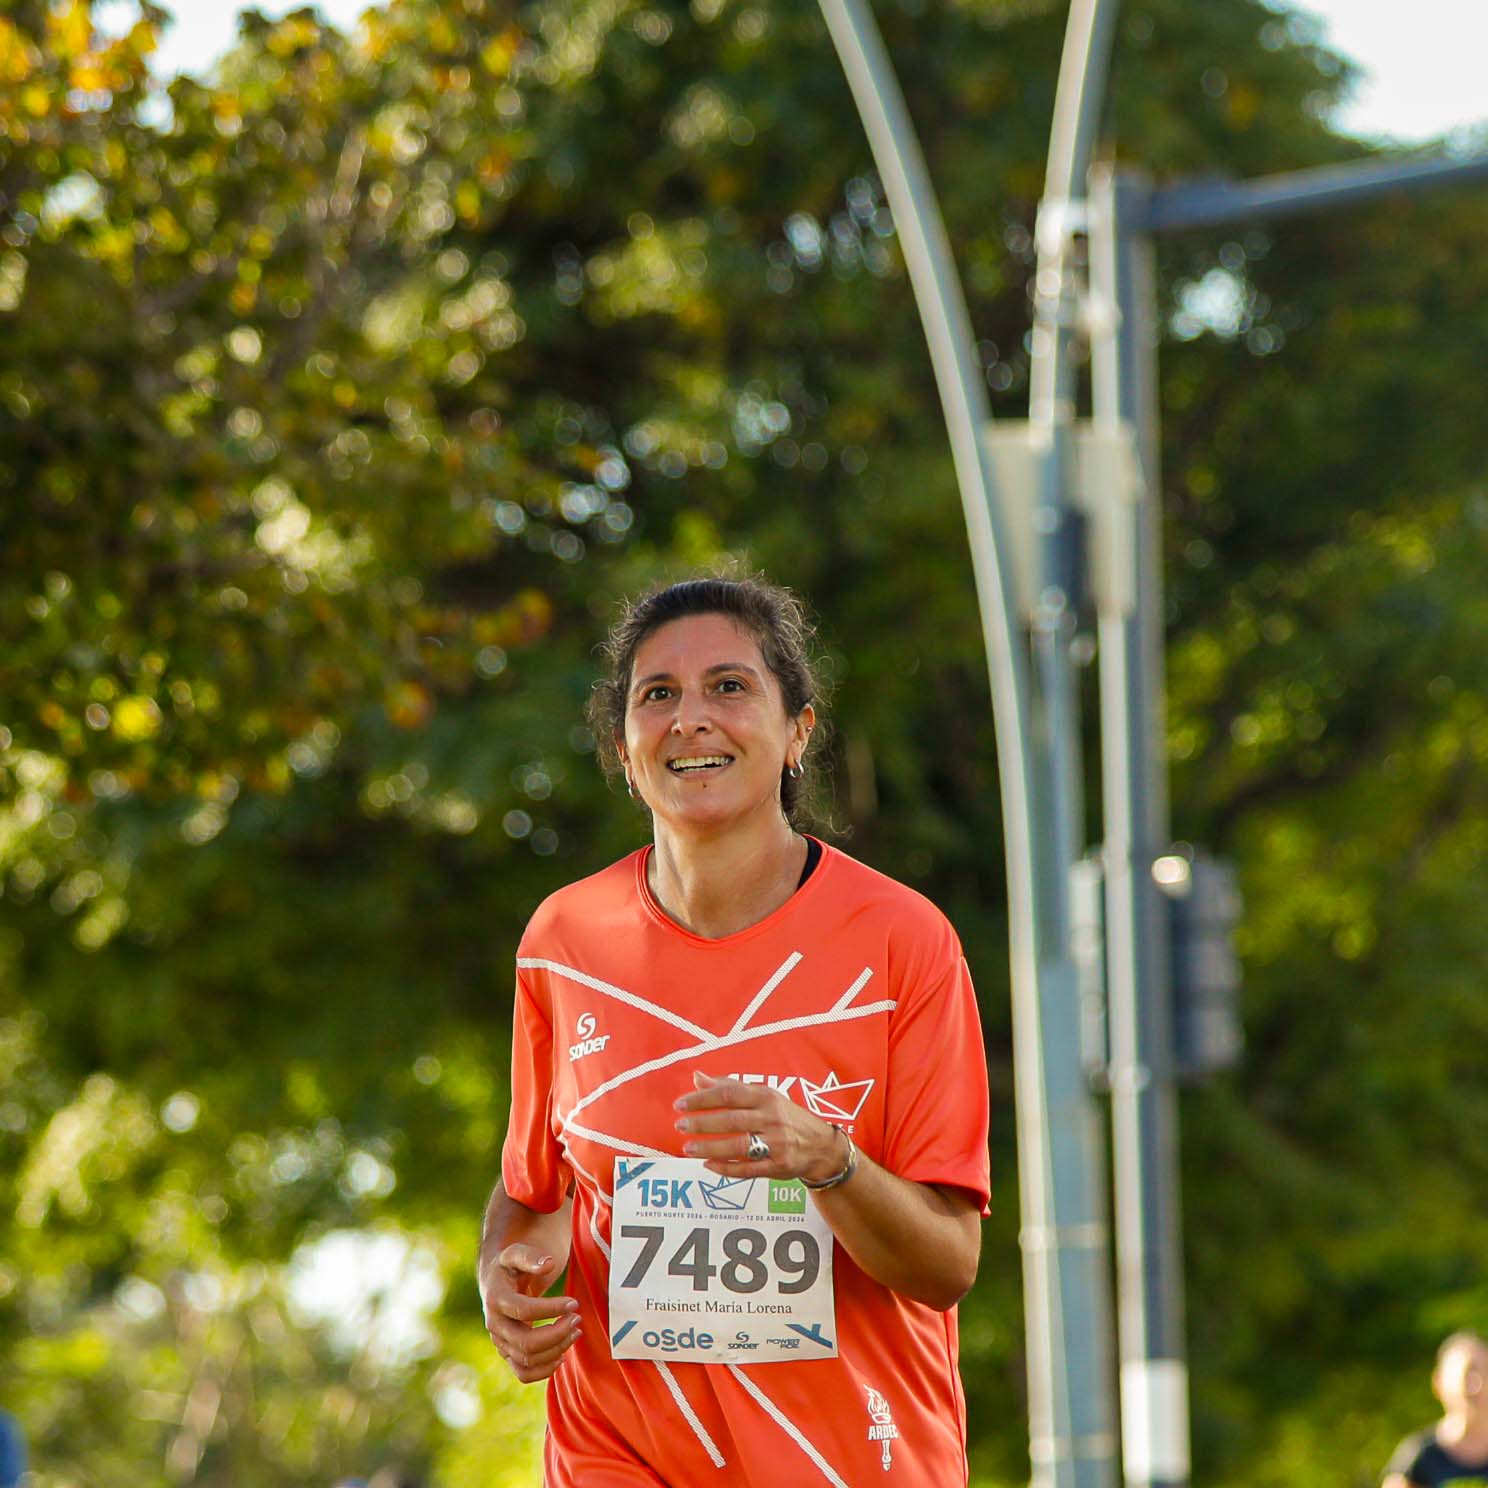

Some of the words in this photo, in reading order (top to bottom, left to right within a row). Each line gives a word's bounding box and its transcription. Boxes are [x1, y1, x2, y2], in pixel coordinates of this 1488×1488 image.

[637, 1178, 694, 1209] 15K
[772, 1186, 802, 1203] 10K
[663, 1211, 684, 1219] NORTE
[709, 1213, 740, 1221] ROSARIO
[619, 1225, 821, 1295] 7489
[646, 1298, 701, 1312] Fraisinet
[705, 1300, 743, 1314] María
[747, 1301, 793, 1314] Lorena
[642, 1327, 714, 1352] osde
